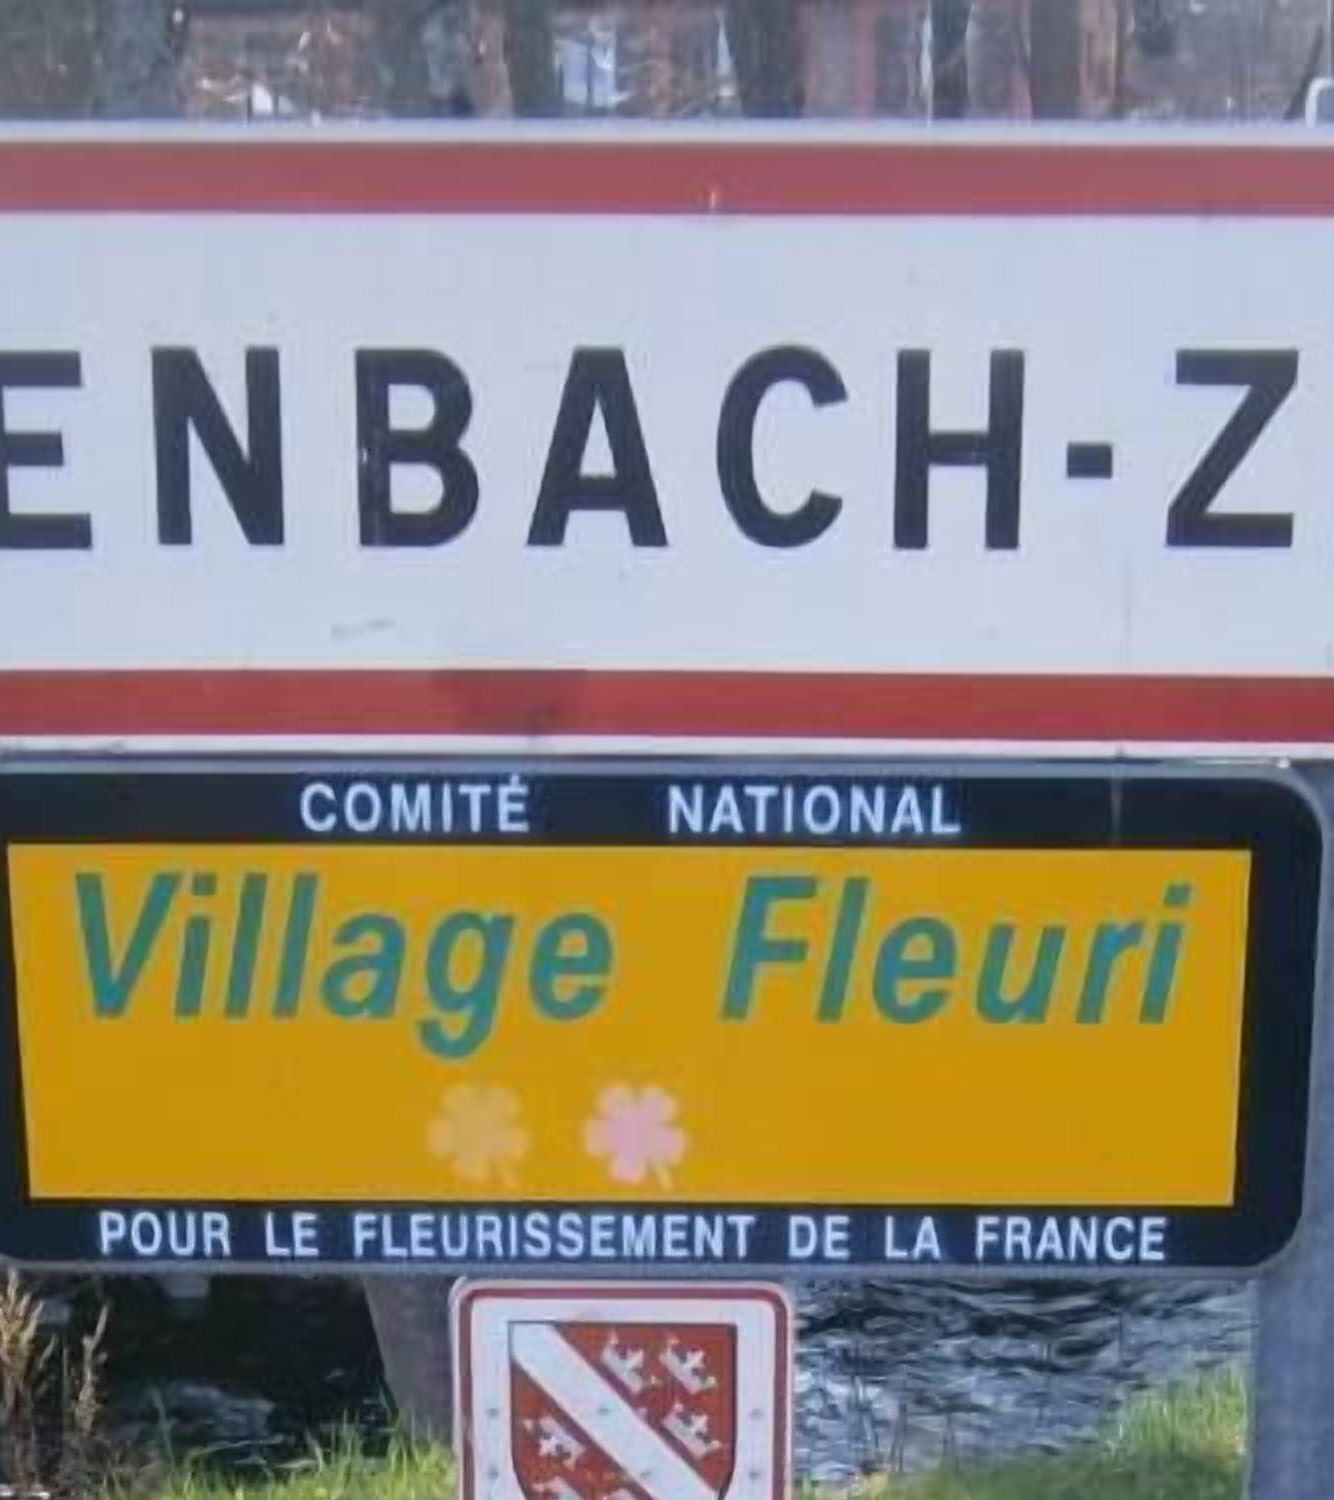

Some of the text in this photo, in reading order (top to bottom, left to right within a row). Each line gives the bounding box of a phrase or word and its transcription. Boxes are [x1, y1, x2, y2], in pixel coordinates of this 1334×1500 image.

[299, 772, 962, 836] COMITÉ NATIONAL
[74, 870, 1192, 1060] Village Fleuri
[98, 1209, 1167, 1262] POUR LE FLEURISSEMENT DE LA FRANCE
